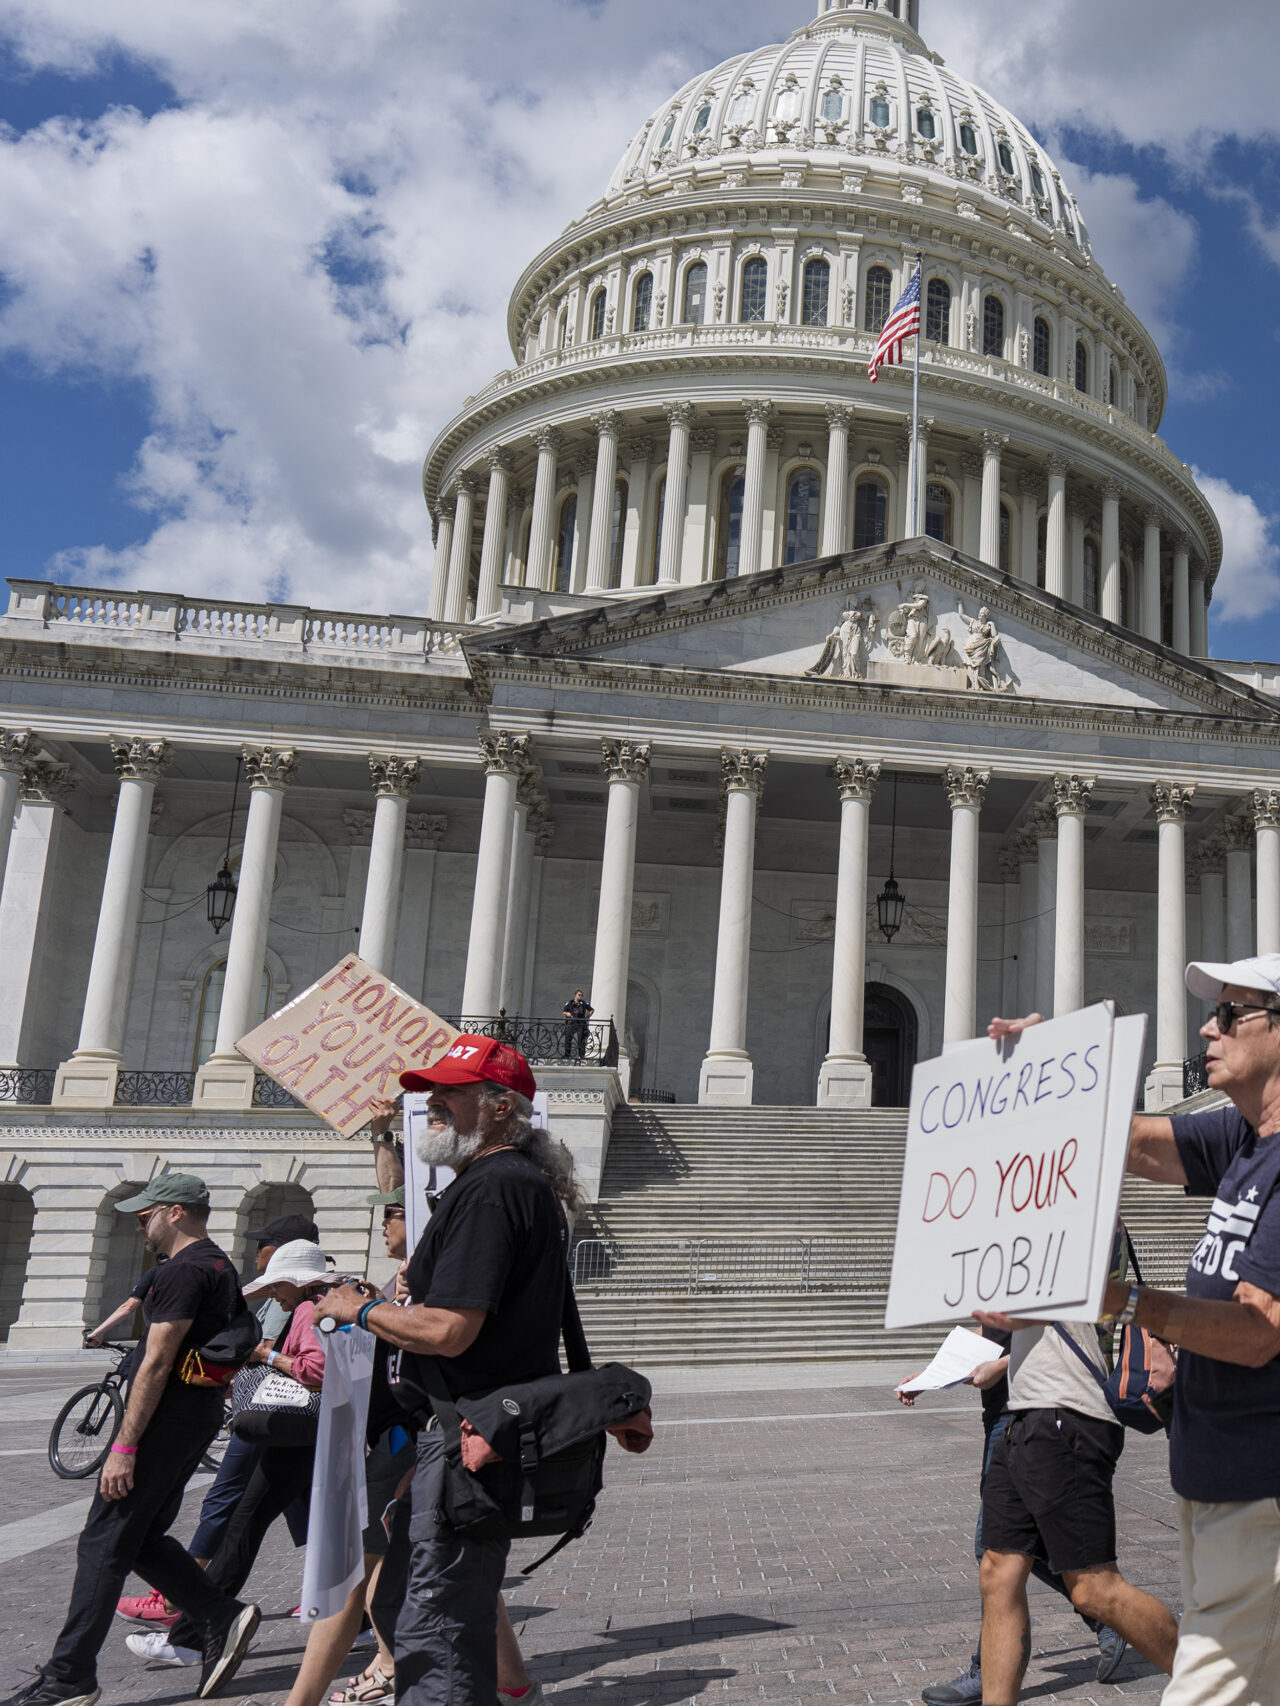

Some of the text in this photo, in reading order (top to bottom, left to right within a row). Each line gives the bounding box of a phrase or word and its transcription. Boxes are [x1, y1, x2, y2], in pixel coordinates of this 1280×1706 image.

[301, 1001, 408, 1095] YOUR
[320, 962, 452, 1067] HONOR
[260, 1034, 375, 1130] OATH
[919, 1044, 1100, 1134] CONGRESS
[922, 1138, 1078, 1222] DO YOUR
[944, 1230, 1066, 1307] JOB!!
